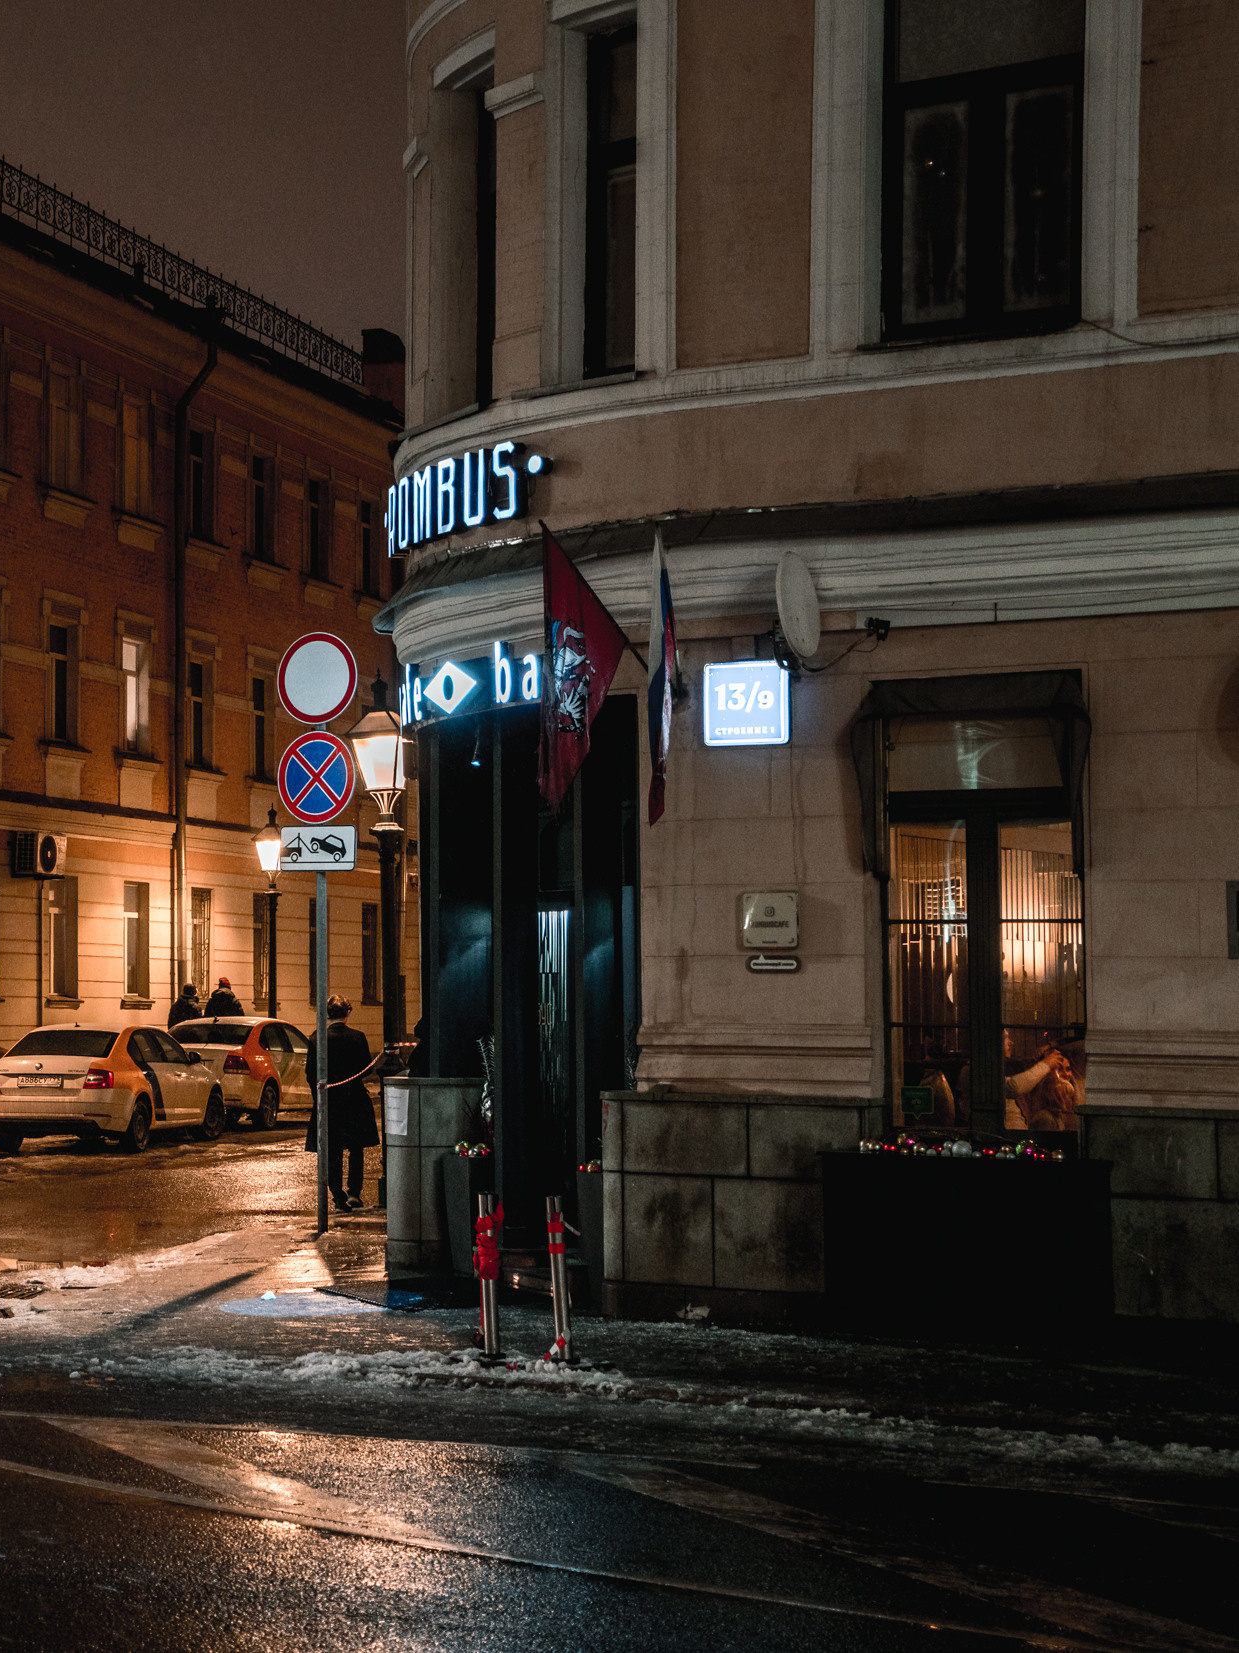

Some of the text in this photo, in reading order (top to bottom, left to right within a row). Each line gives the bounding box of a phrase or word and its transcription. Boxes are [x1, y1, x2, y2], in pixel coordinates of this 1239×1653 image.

[388, 440, 517, 559] ROMBUS
[714, 680, 775, 713] 13/9
[714, 725, 775, 736] СТРОЕНИЕ 1
